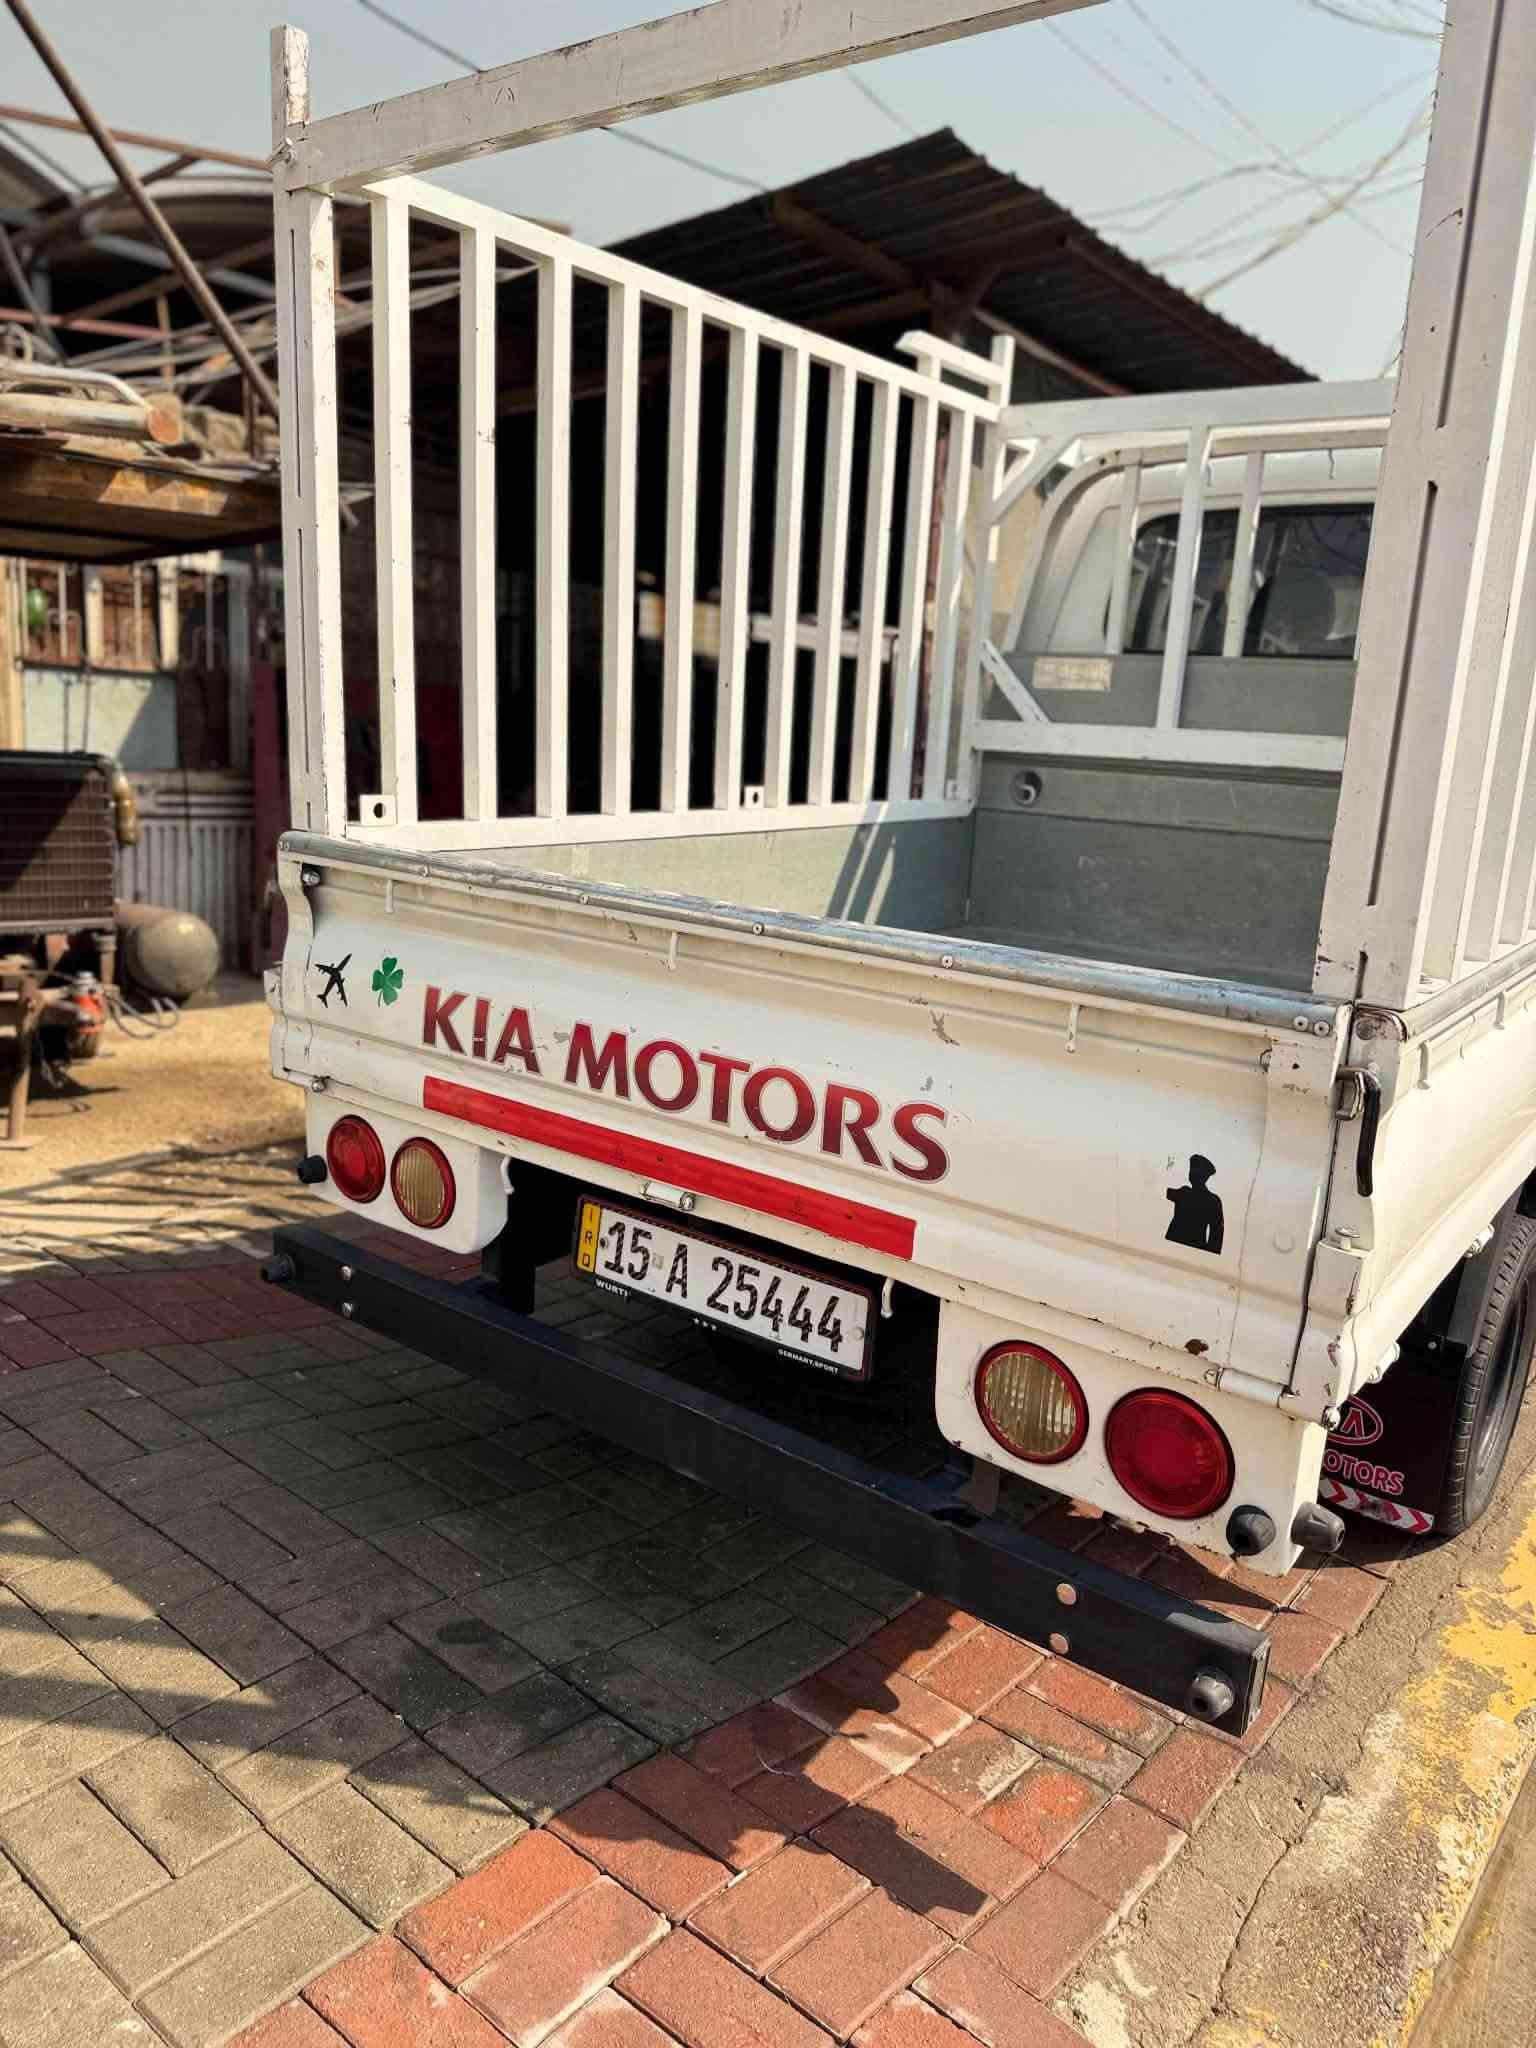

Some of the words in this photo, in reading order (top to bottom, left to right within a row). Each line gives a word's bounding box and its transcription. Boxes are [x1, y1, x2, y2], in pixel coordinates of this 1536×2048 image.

[422, 984, 543, 1076] KIA
[563, 1020, 949, 1183] MOTORS
[604, 1221, 652, 1280] 15
[665, 1242, 688, 1299] A
[706, 1256, 843, 1353] 25444
[1323, 1448, 1405, 1496] OTORS
